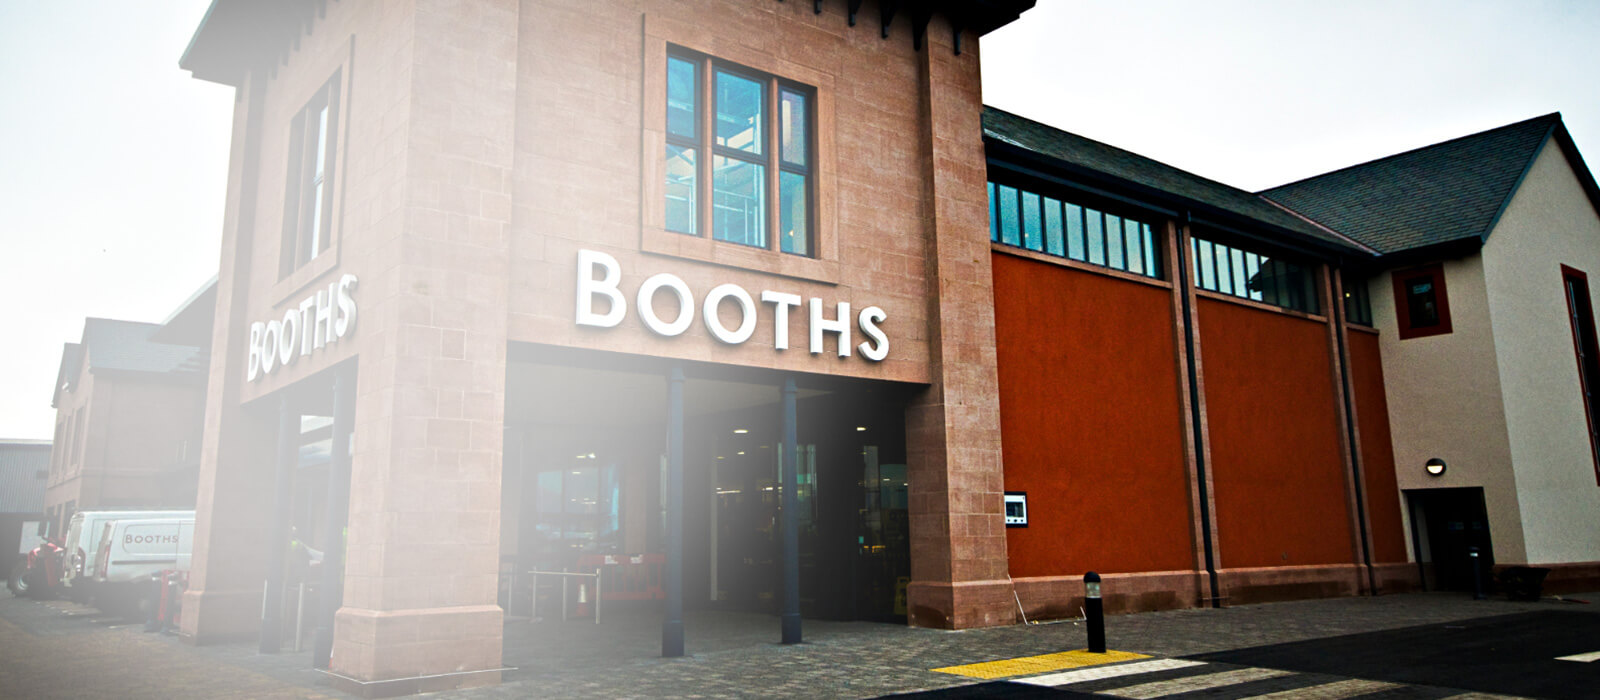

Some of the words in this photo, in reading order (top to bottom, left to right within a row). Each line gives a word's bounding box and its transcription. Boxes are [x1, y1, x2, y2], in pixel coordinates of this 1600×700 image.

[247, 273, 358, 382] BOOTHS
[576, 248, 889, 361] BOOTHS
[125, 534, 179, 544] BOOTHS
